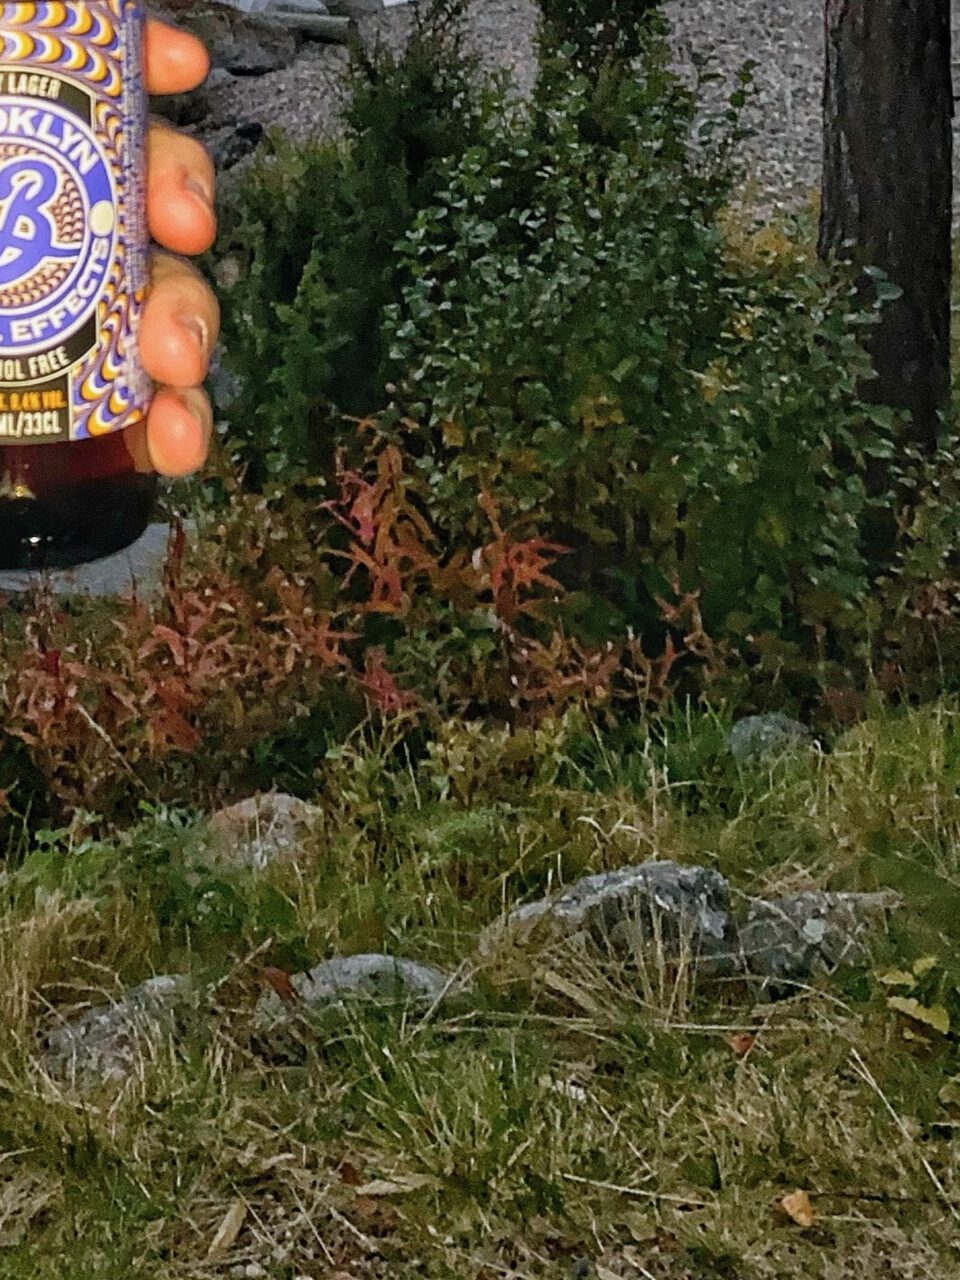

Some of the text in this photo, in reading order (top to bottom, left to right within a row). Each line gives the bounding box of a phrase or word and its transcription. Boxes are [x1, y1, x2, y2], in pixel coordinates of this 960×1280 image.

[7, 72, 62, 100] LAGER
[9, 236, 111, 343] EFFECTS
[28, 345, 71, 378] FREE
